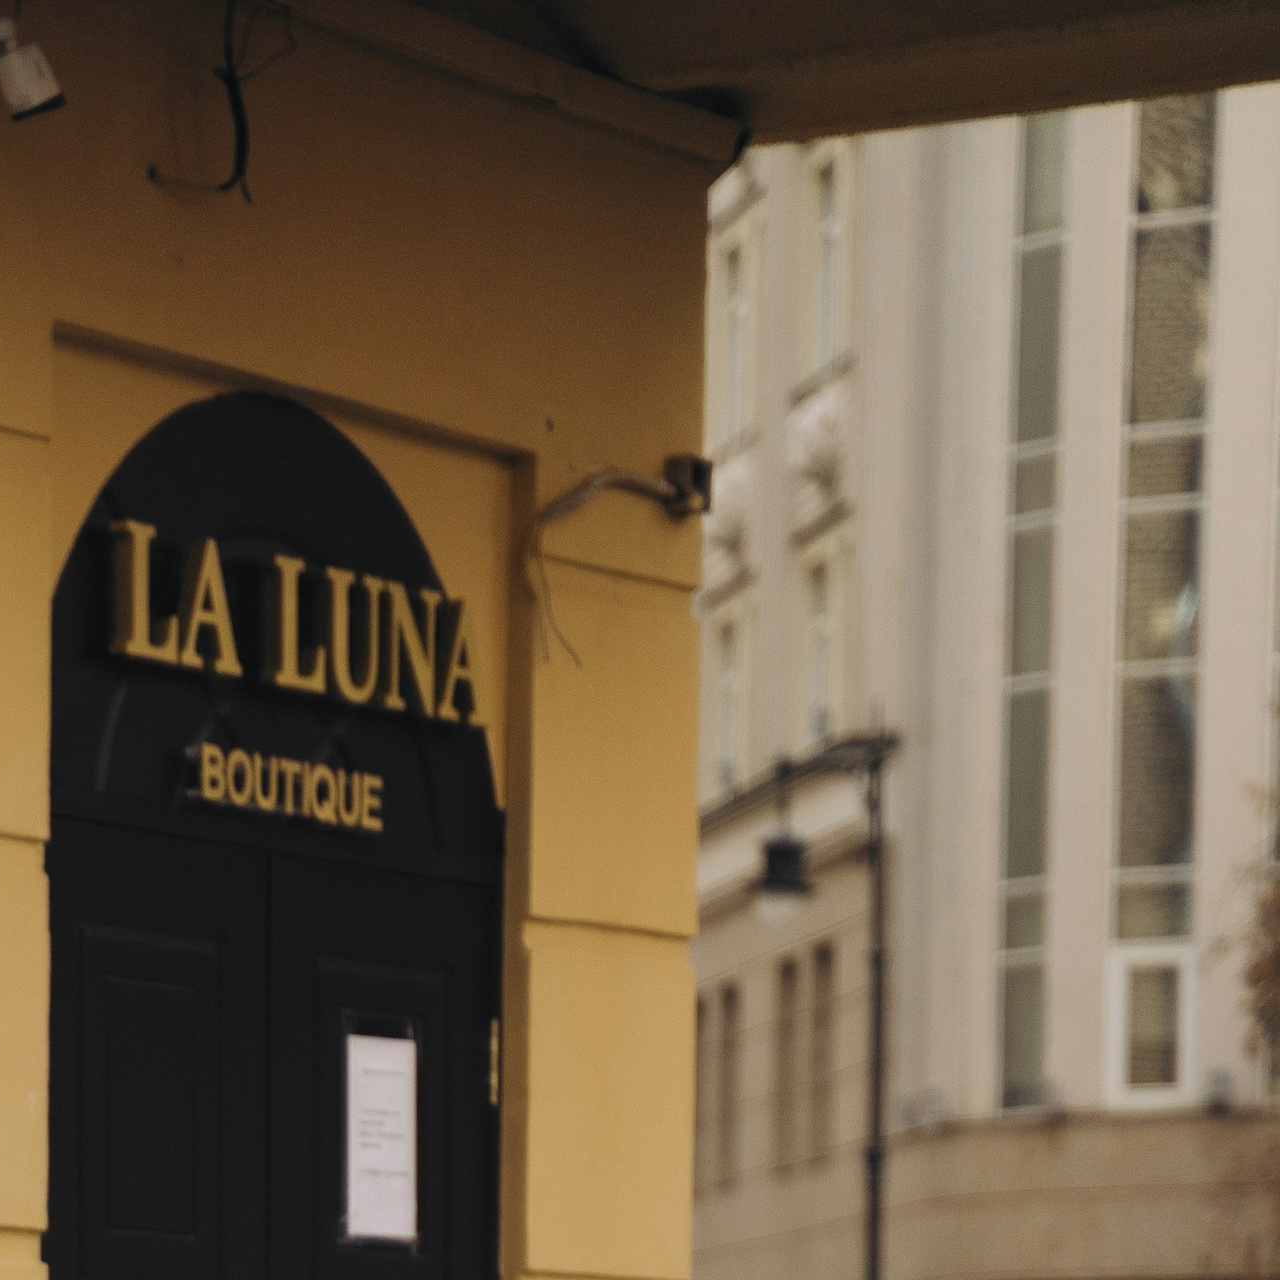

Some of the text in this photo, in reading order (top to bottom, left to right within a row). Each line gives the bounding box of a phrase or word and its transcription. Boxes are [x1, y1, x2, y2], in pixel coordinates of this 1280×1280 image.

[114, 518, 488, 728] LA LUNA
[199, 740, 384, 832] BOUTIQUE
